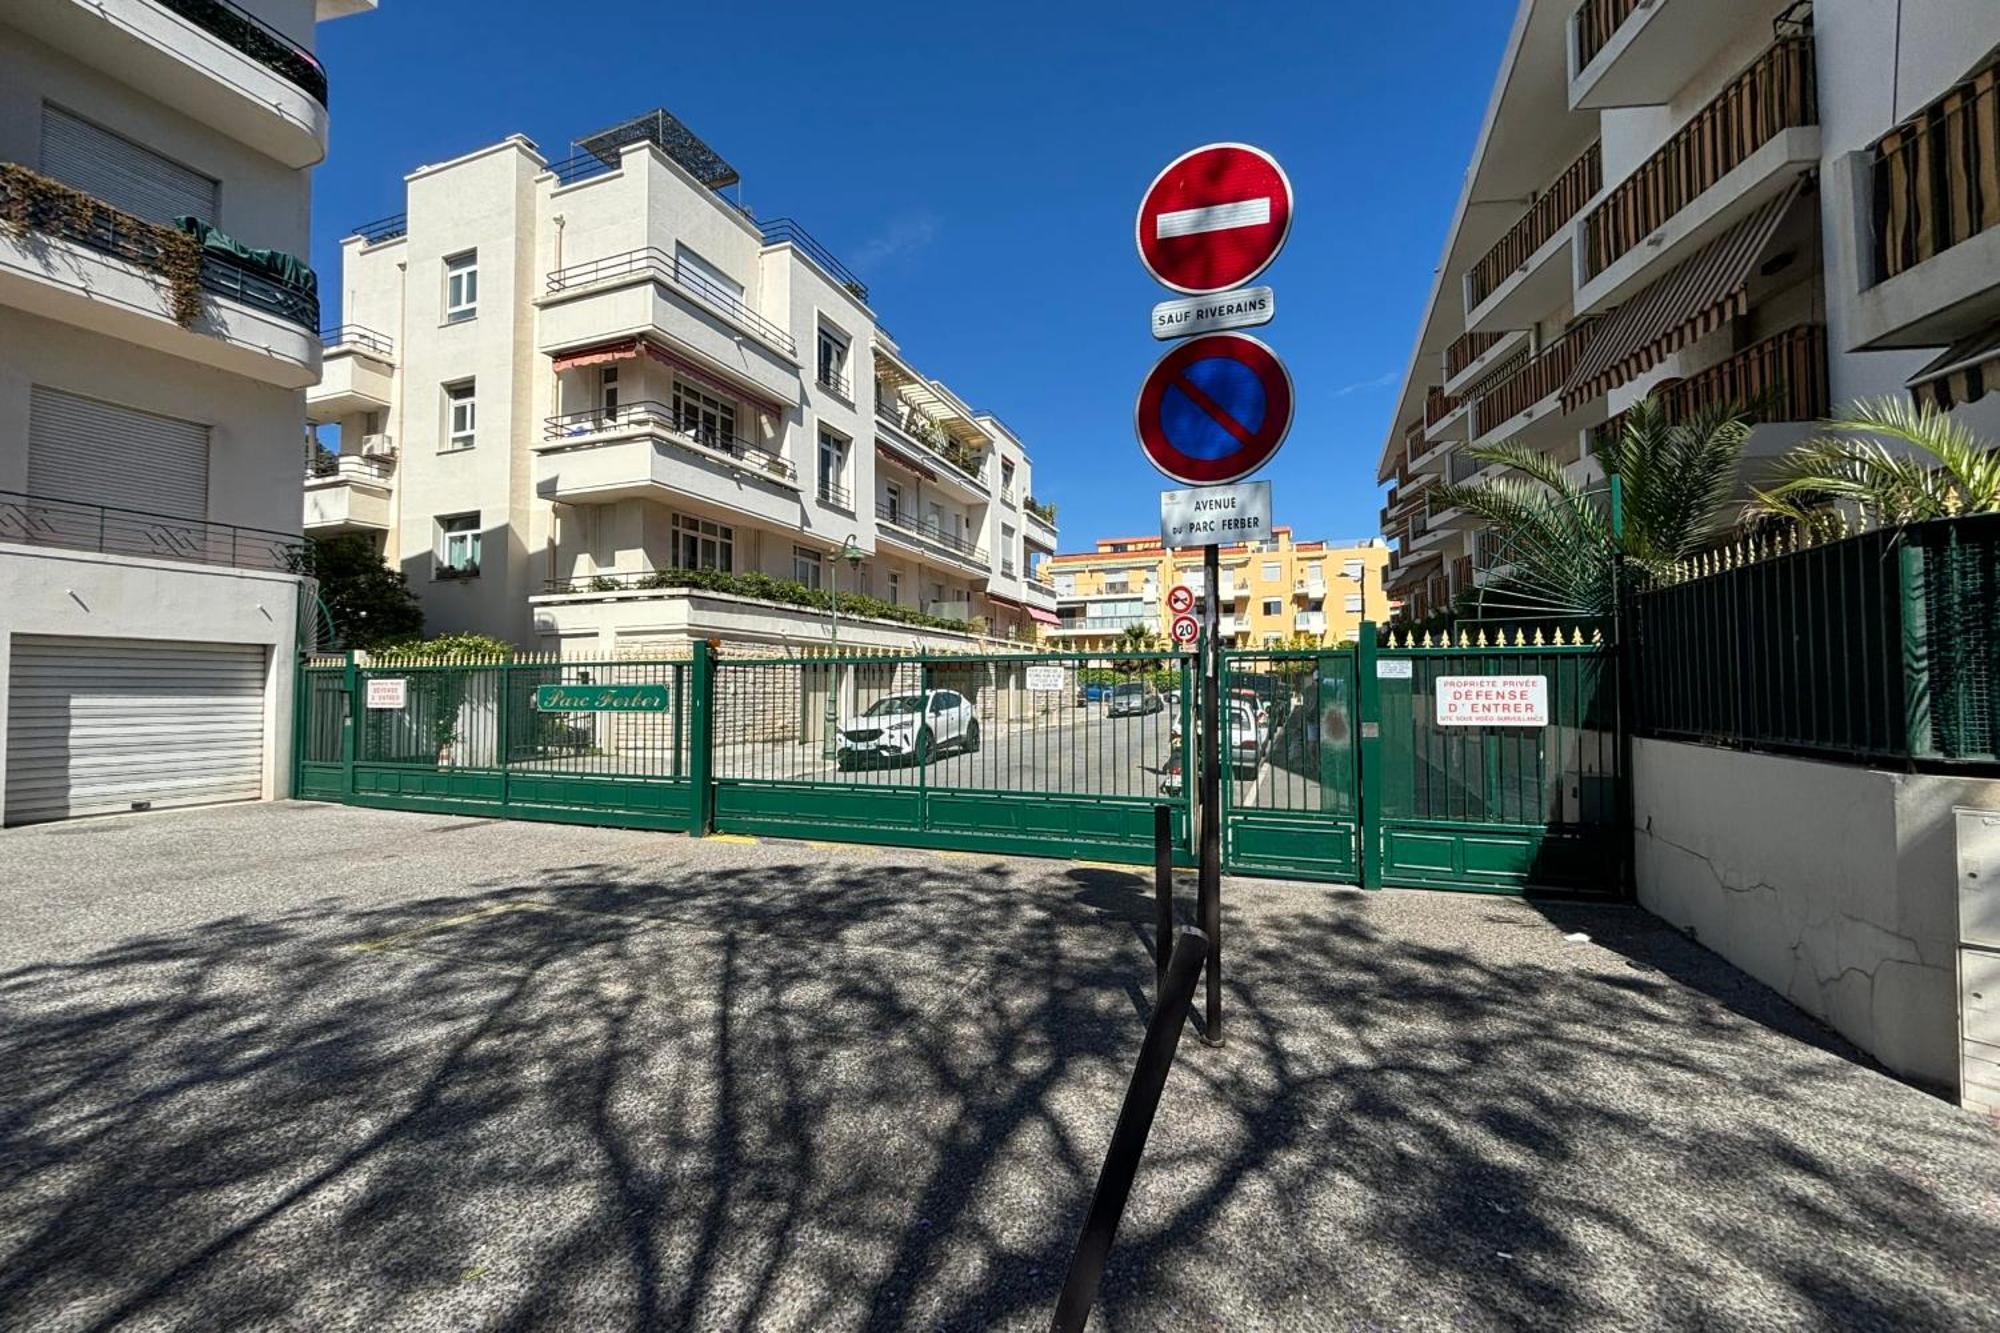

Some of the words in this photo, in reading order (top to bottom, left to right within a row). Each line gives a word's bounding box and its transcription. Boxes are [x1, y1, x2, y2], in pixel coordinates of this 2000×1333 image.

[1158, 311, 1191, 326] SAUF
[1196, 299, 1266, 320] RIVERAINS
[1194, 496, 1237, 512] AVENUE
[1172, 527, 1183, 535] DU
[1188, 520, 1215, 533] PARC
[1222, 516, 1260, 531] FERBER
[1178, 623, 1193, 637] 20
[543, 687, 590, 707] Parc
[594, 689, 661, 708] Ferber
